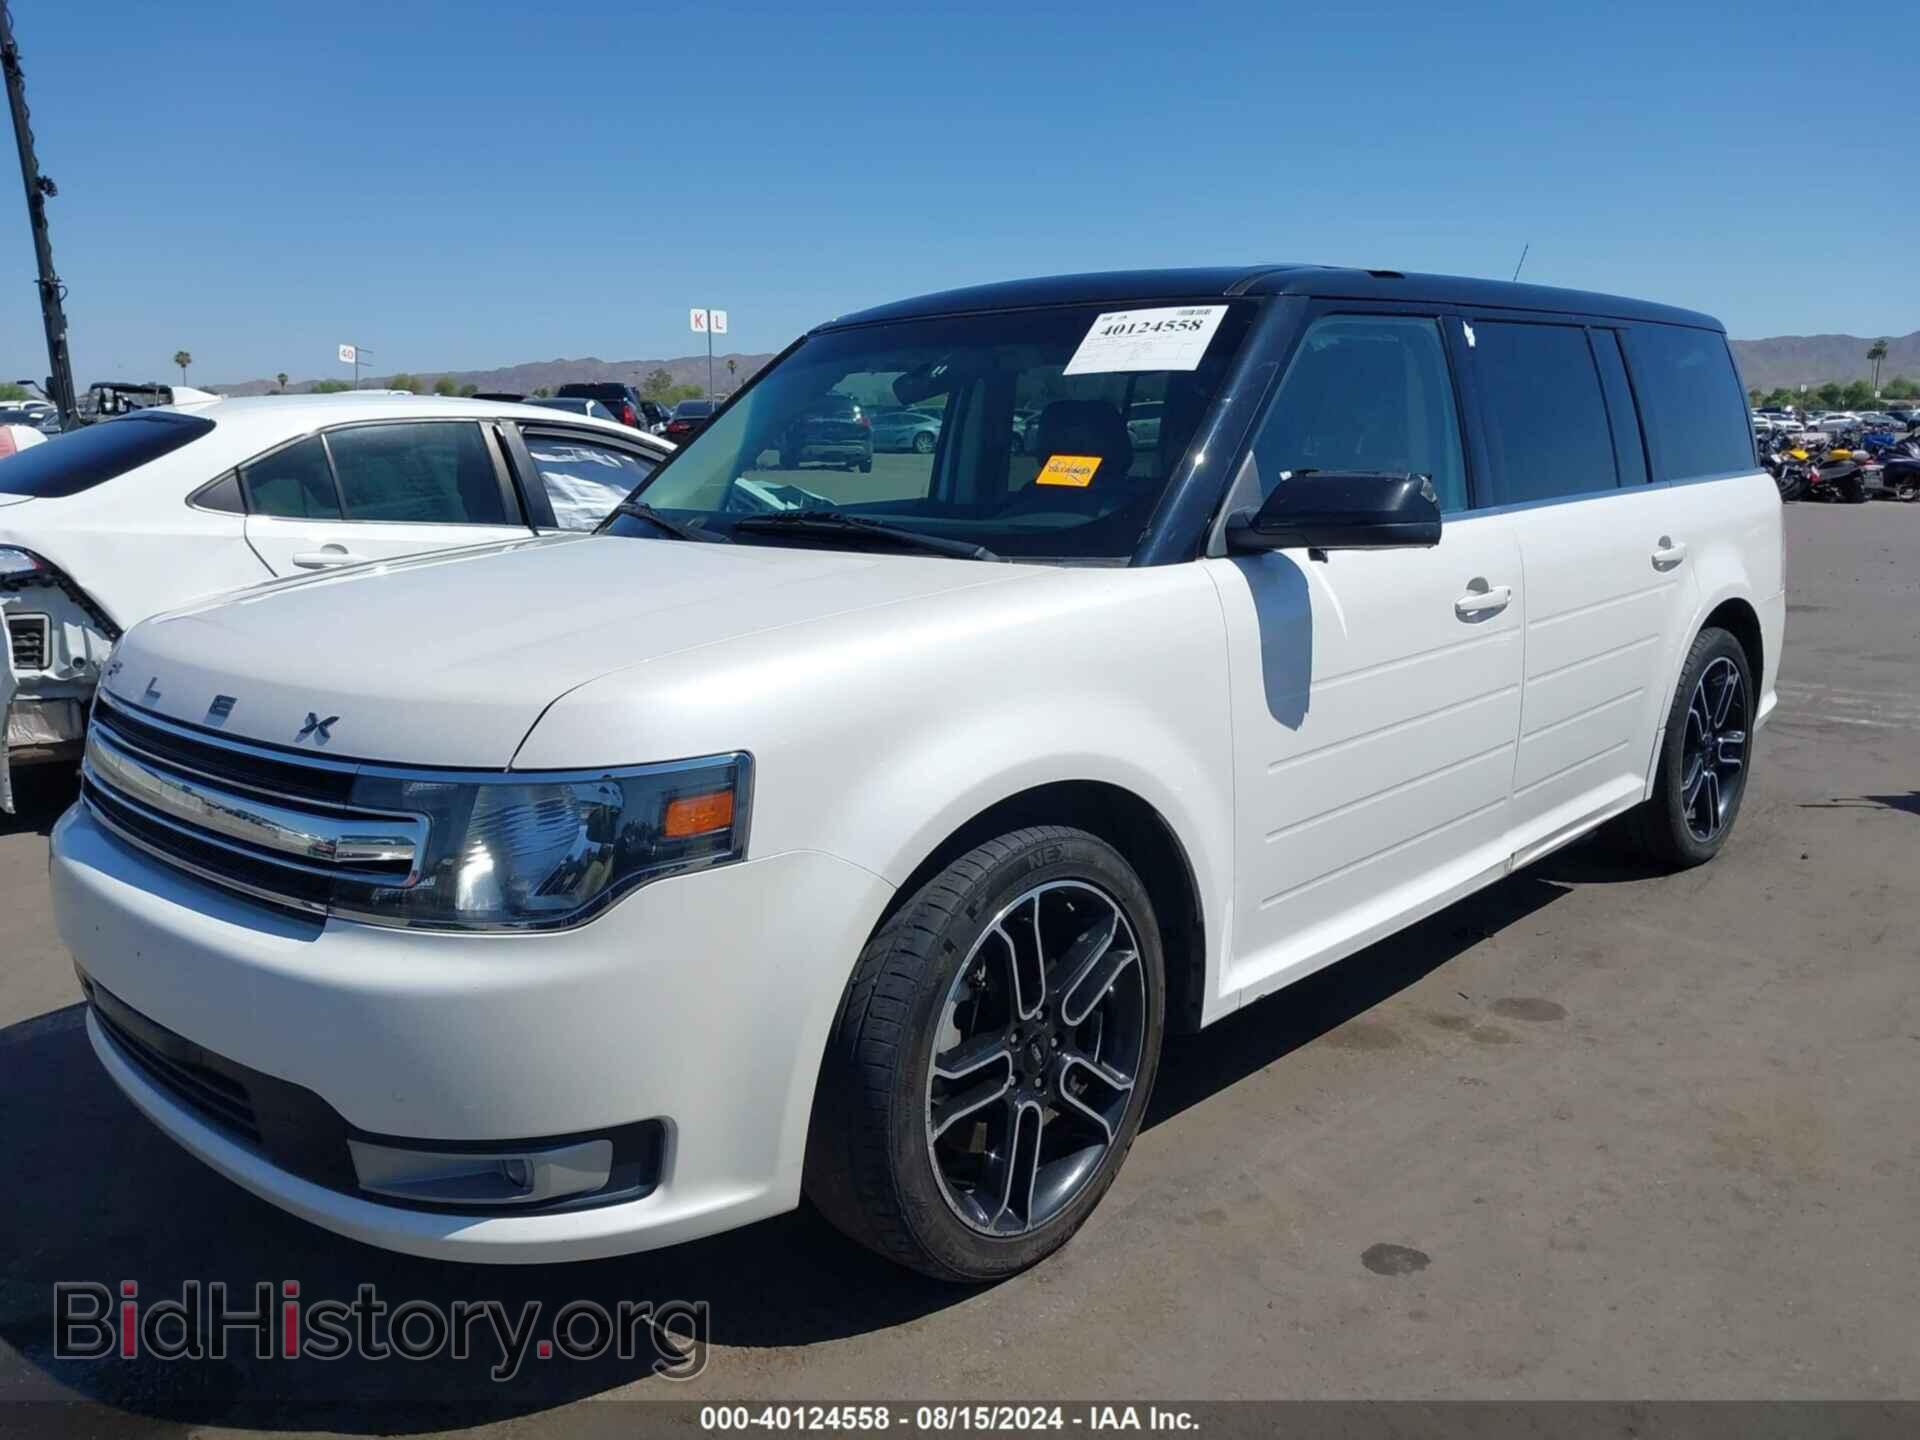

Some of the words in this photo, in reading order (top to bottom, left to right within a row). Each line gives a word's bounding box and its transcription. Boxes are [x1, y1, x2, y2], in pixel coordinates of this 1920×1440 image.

[693, 313, 704, 328] K
[714, 315, 724, 330] L
[1100, 320, 1203, 338] 40124558
[341, 348, 354, 360] 40
